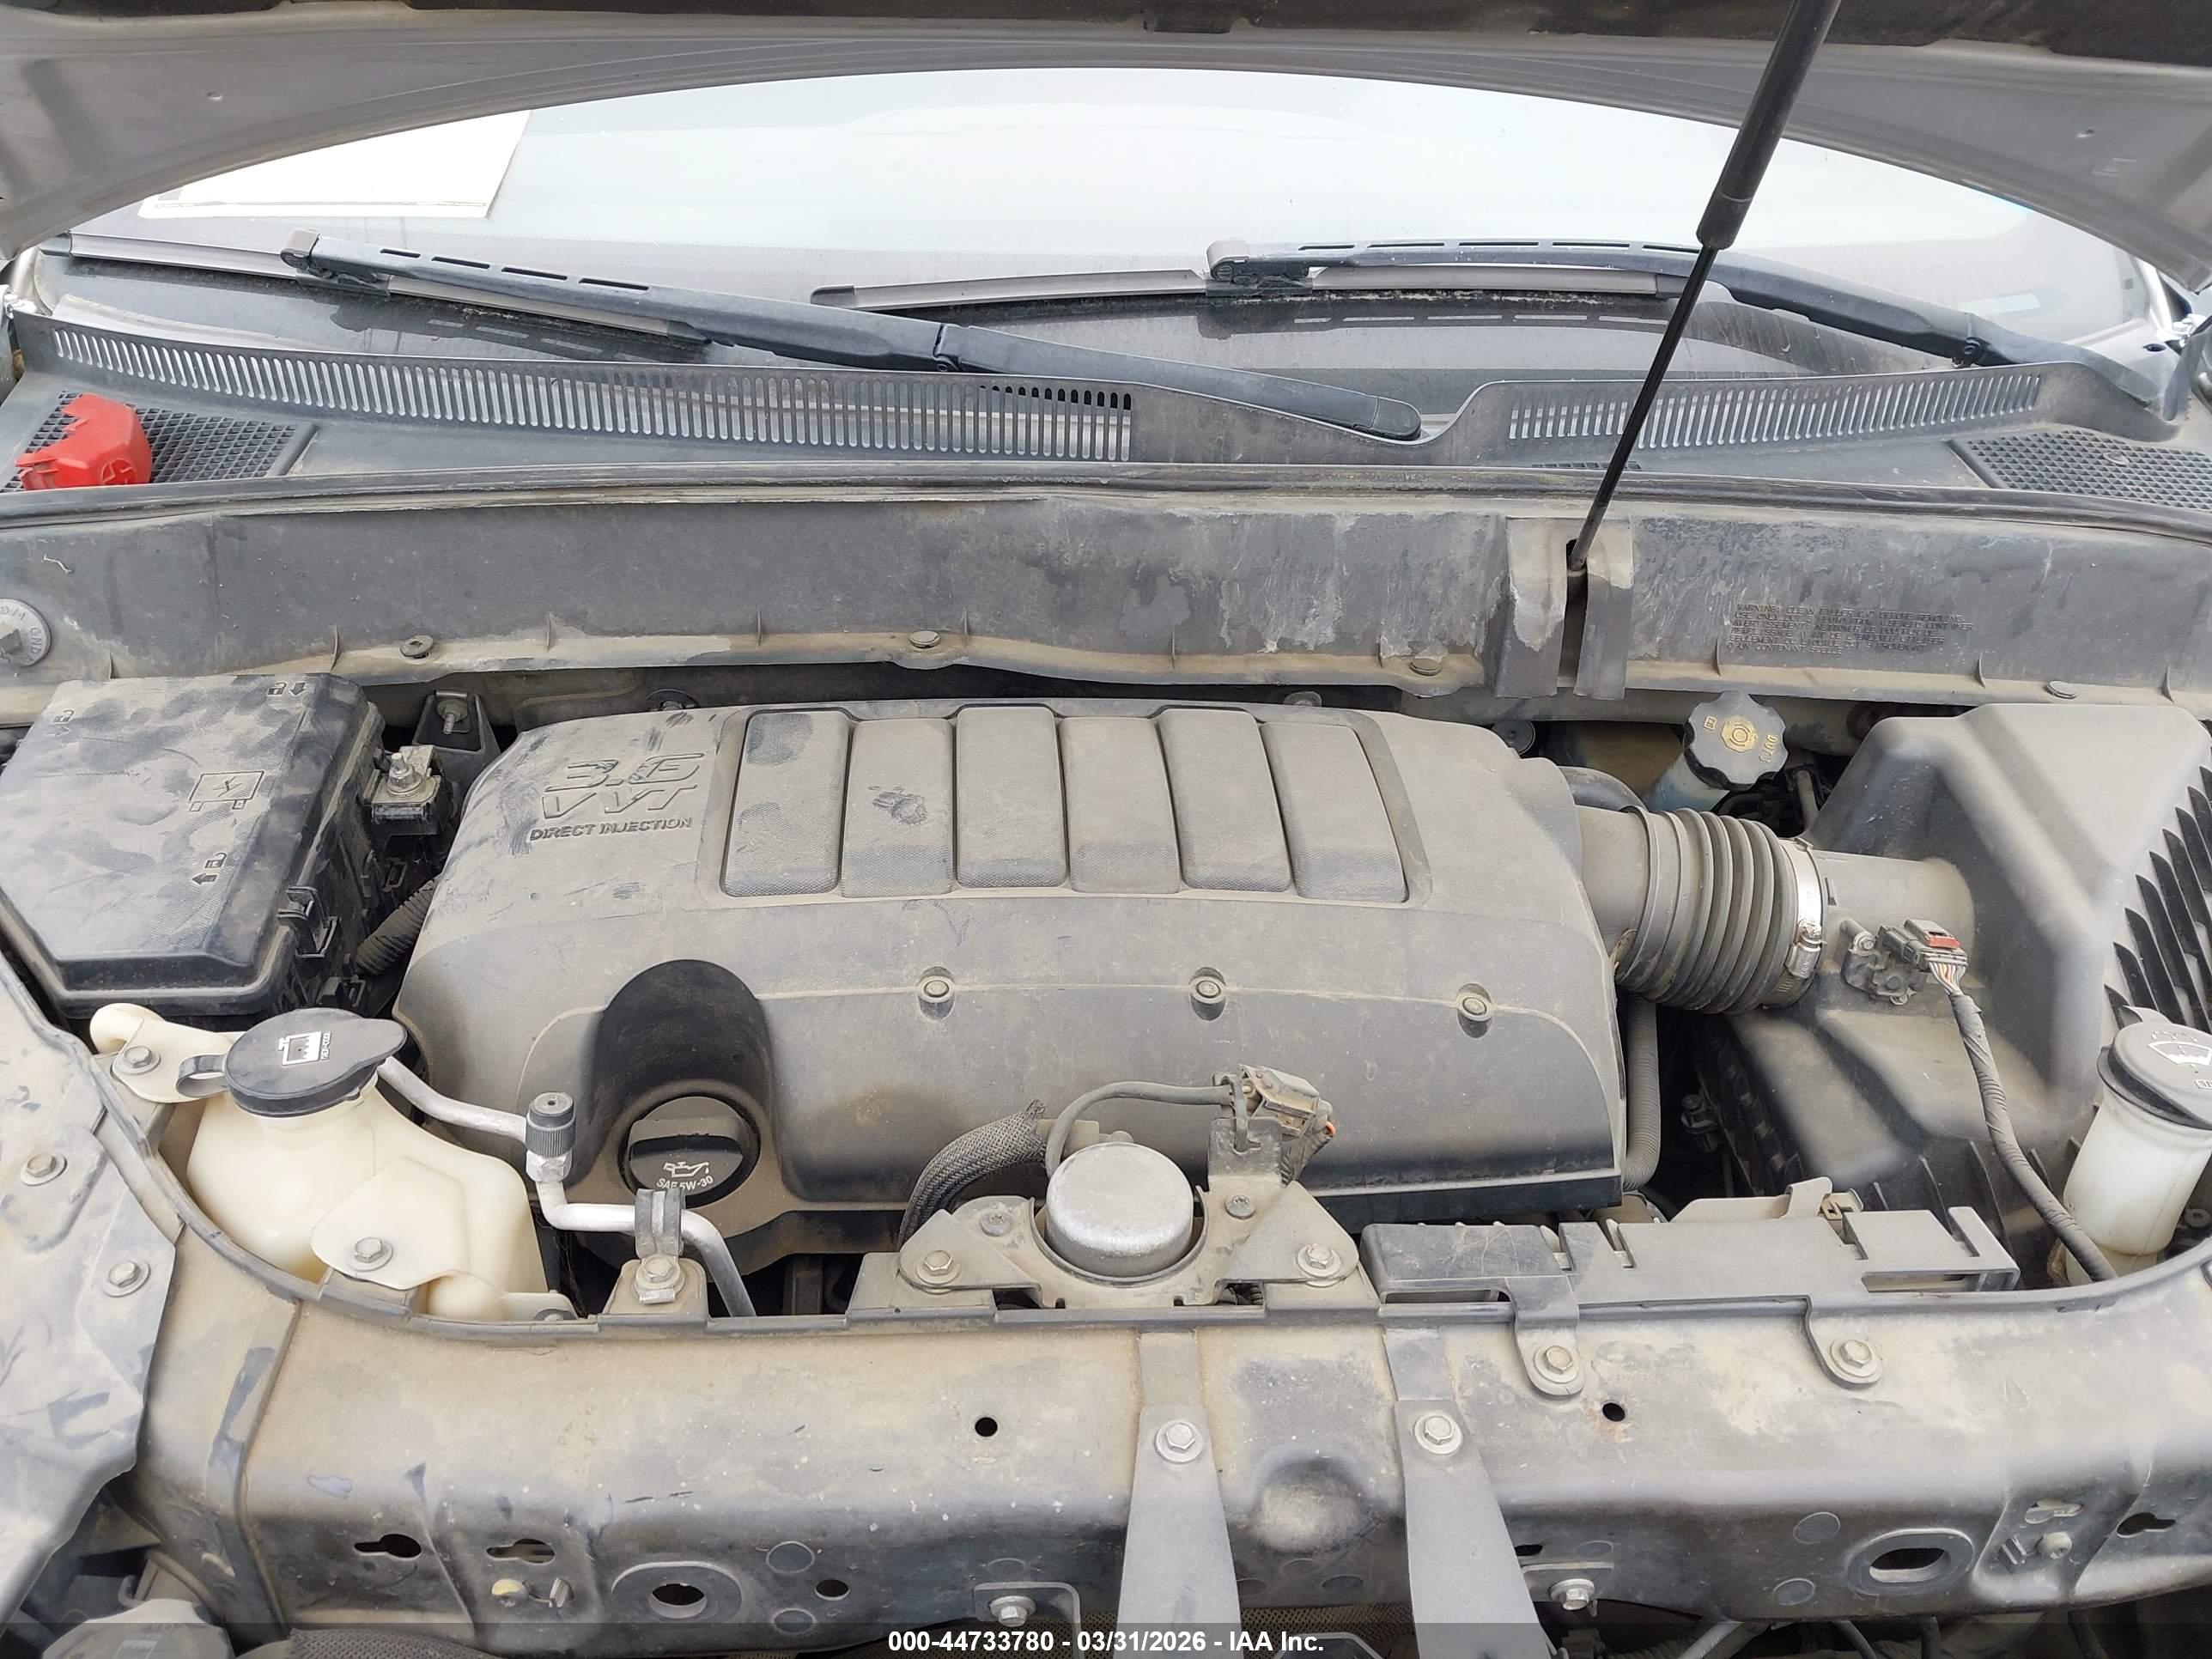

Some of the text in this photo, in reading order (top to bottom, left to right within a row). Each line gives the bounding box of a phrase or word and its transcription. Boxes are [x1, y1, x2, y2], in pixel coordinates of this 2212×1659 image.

[544, 752, 705, 793] 3.6
[542, 785, 698, 819] VVT
[530, 817, 692, 842] DIRECT INJECTION
[678, 1175, 714, 1191] 5W-30
